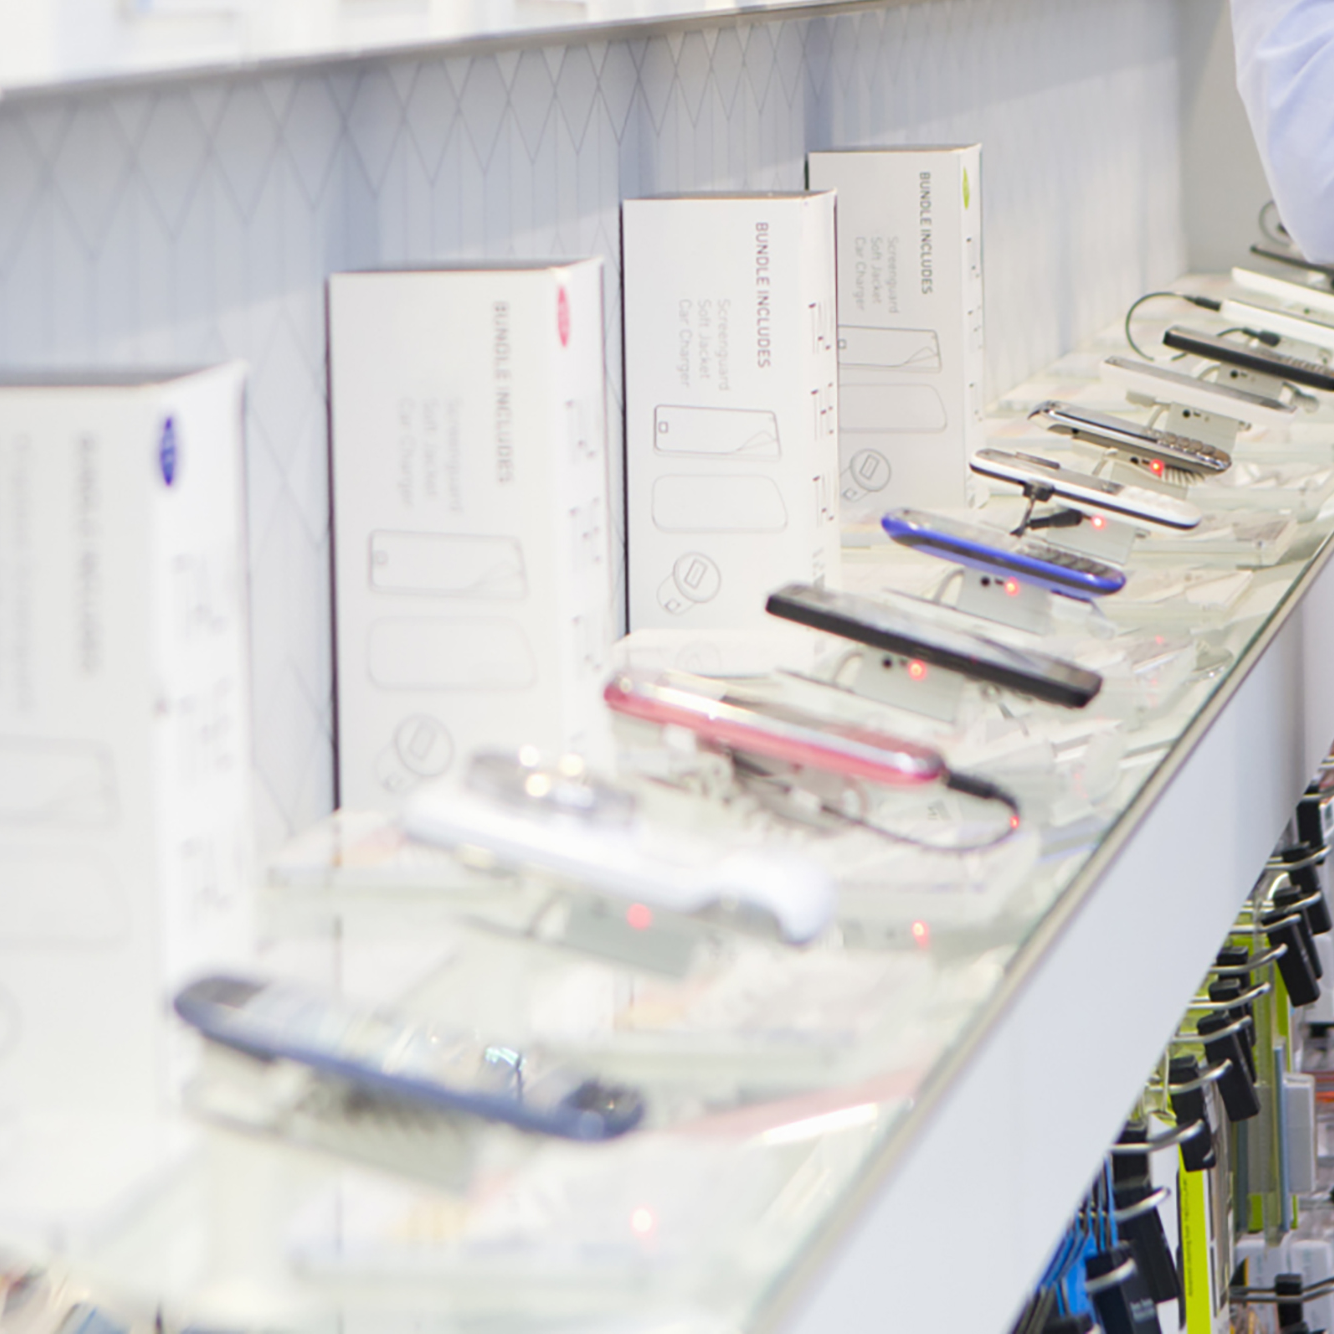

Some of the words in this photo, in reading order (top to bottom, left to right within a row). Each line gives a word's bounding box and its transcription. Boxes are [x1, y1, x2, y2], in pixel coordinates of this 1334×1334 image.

[919, 171, 932, 226] BUNDLE
[755, 221, 770, 286] BUNDLE
[854, 236, 867, 258] Car
[870, 236, 883, 261] Soft
[885, 236, 900, 314] Screenguard
[920, 228, 934, 295] INCLUDES
[678, 298, 693, 324] Car
[853, 261, 868, 311] Charger
[871, 264, 883, 304] Jacket
[493, 300, 513, 381] BUNDLE
[697, 298, 712, 328] Soft
[756, 290, 772, 369] INCLUDES
[676, 328, 693, 388] Charger
[698, 332, 712, 379] Jacket
[715, 298, 731, 392] Screenguard
[495, 386, 515, 485] INCLUDES
